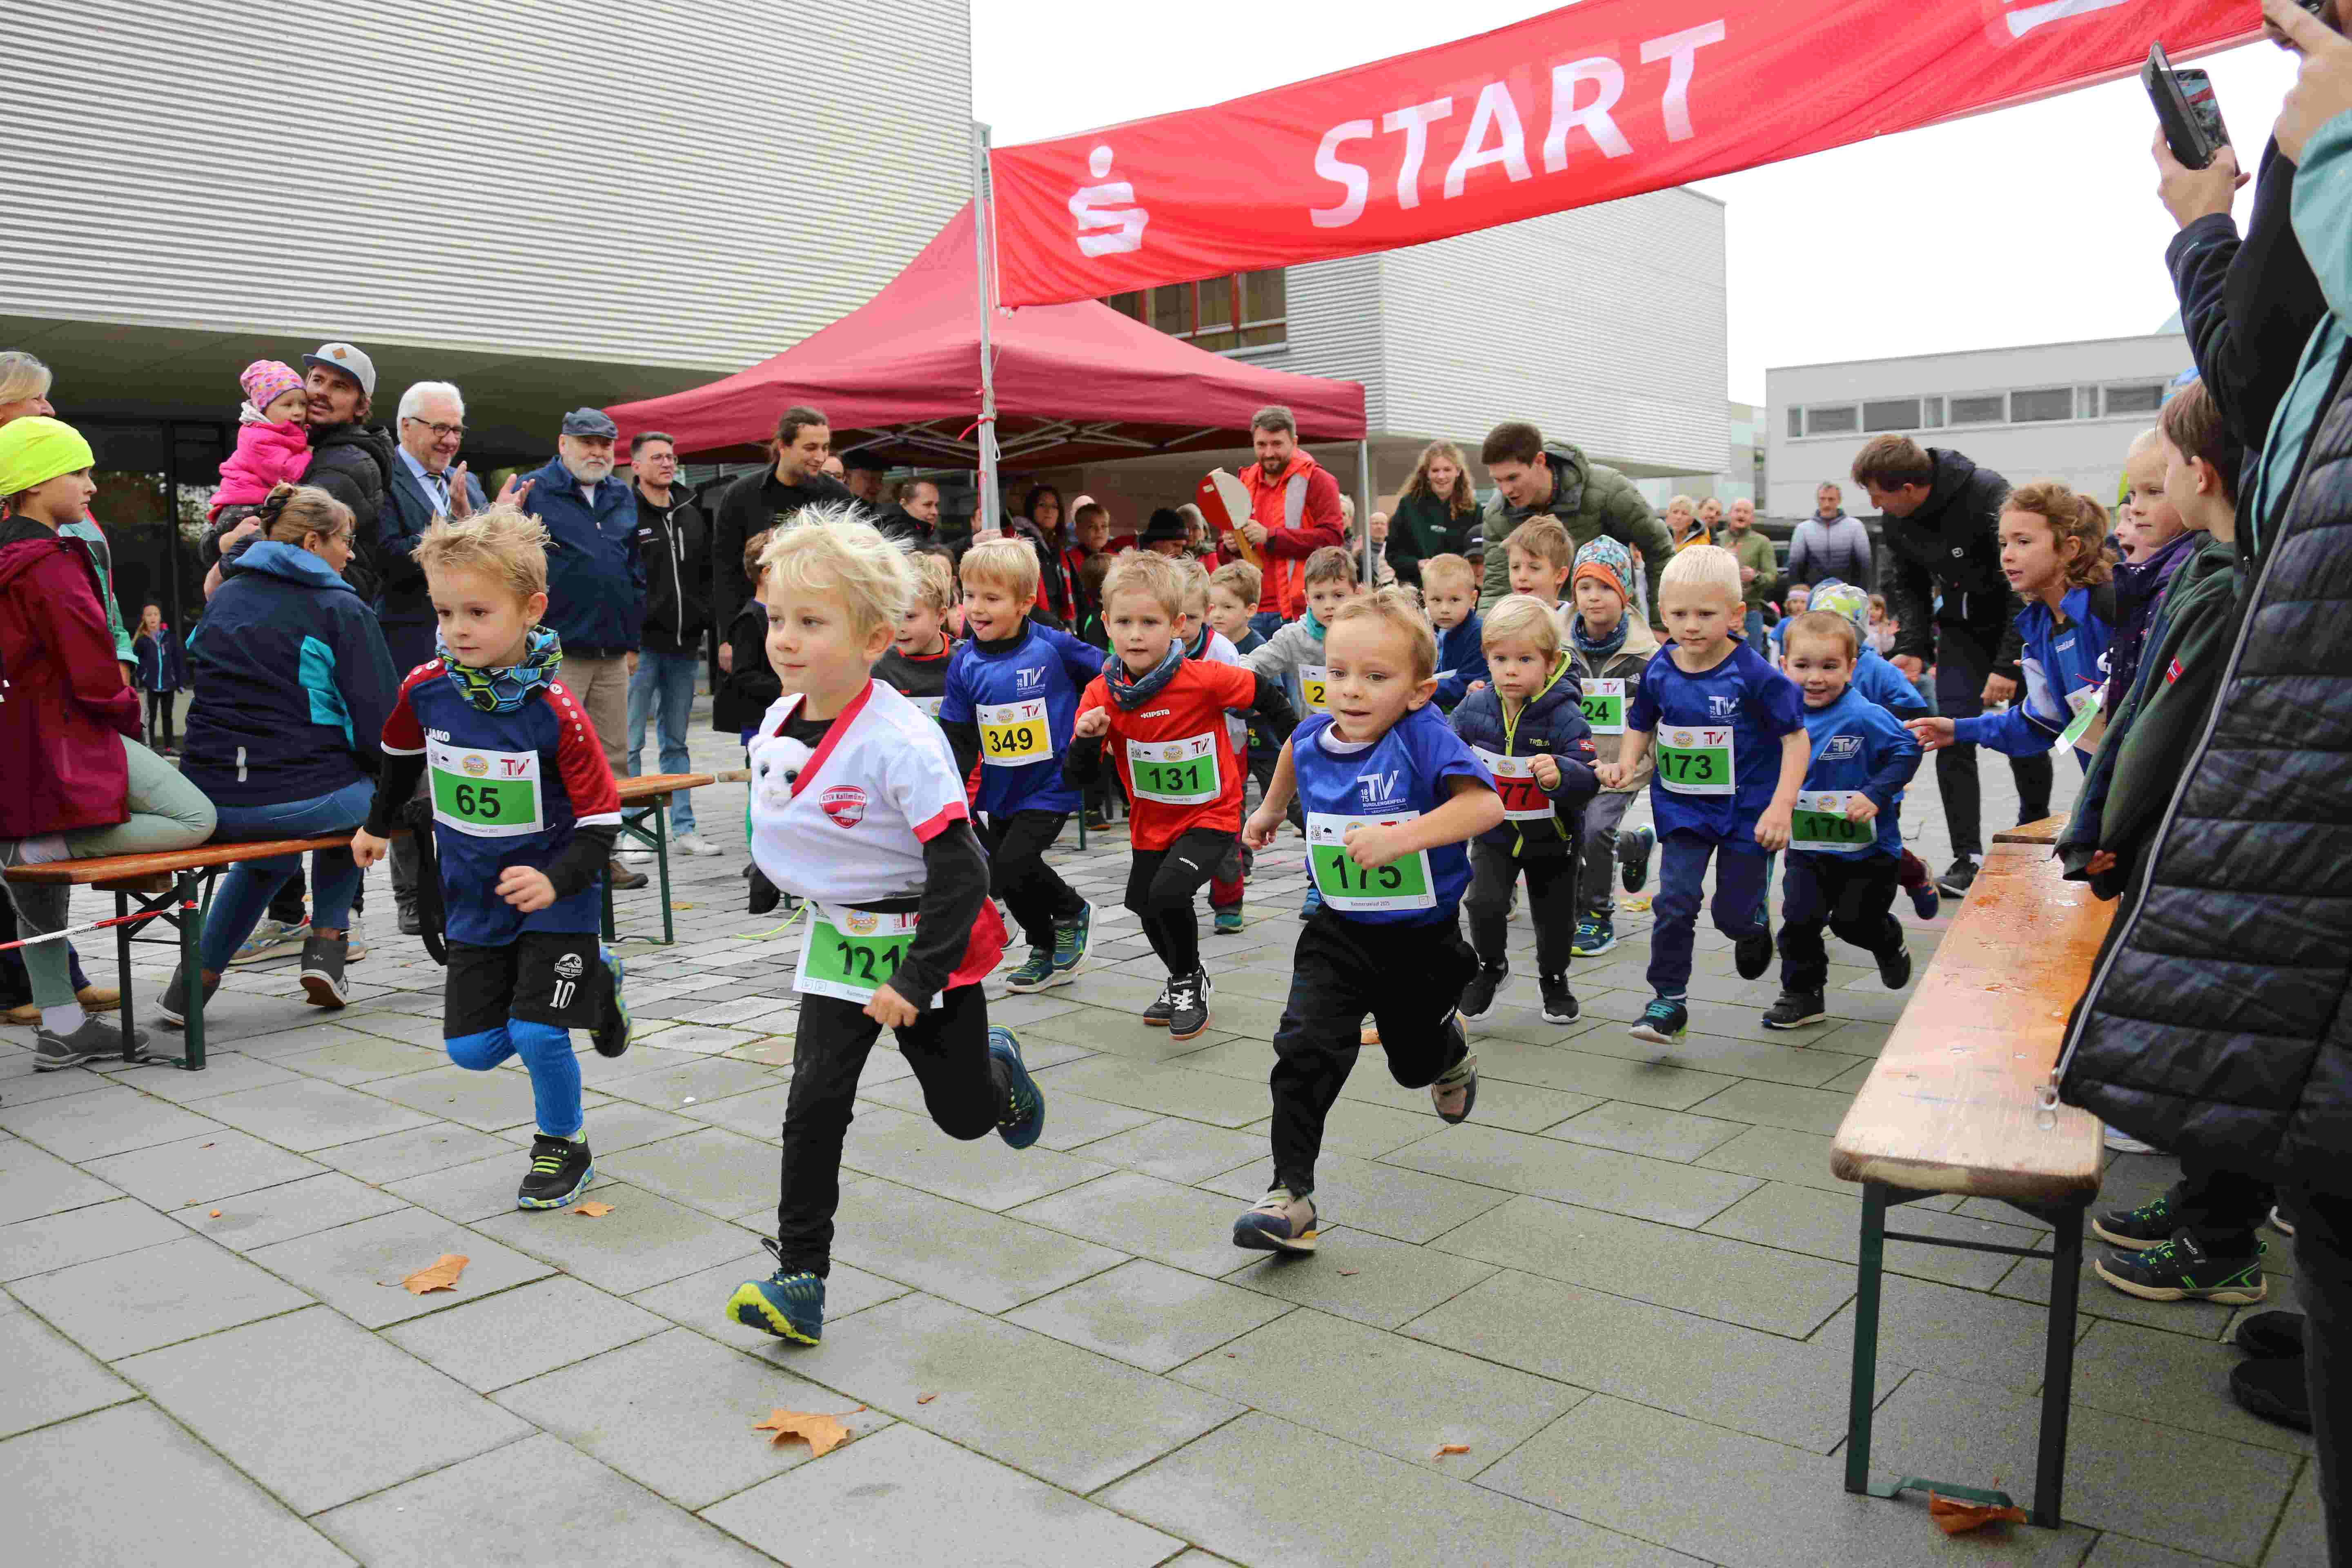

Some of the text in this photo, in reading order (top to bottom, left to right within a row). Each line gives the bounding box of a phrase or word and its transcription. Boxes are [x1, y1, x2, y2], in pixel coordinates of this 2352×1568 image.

[1310, 20, 1725, 229] START
[1016, 666, 1046, 686] TV
[1022, 704, 1042, 717] TV
[1582, 701, 1610, 721] 24
[1708, 696, 1740, 715] TV
[429, 728, 450, 742] JAKO
[989, 728, 1033, 752] 349
[1191, 738, 1210, 754] TV
[1704, 732, 1727, 745] TV
[500, 759, 530, 775] TV
[1662, 752, 1712, 779] 173
[1149, 764, 1198, 791] 131
[1357, 770, 1399, 801] TV
[456, 784, 501, 818] 65
[1499, 782, 1532, 806] 77
[1805, 817, 1855, 837] 170
[837, 940, 900, 982] 121
[549, 980, 576, 1009] 10
